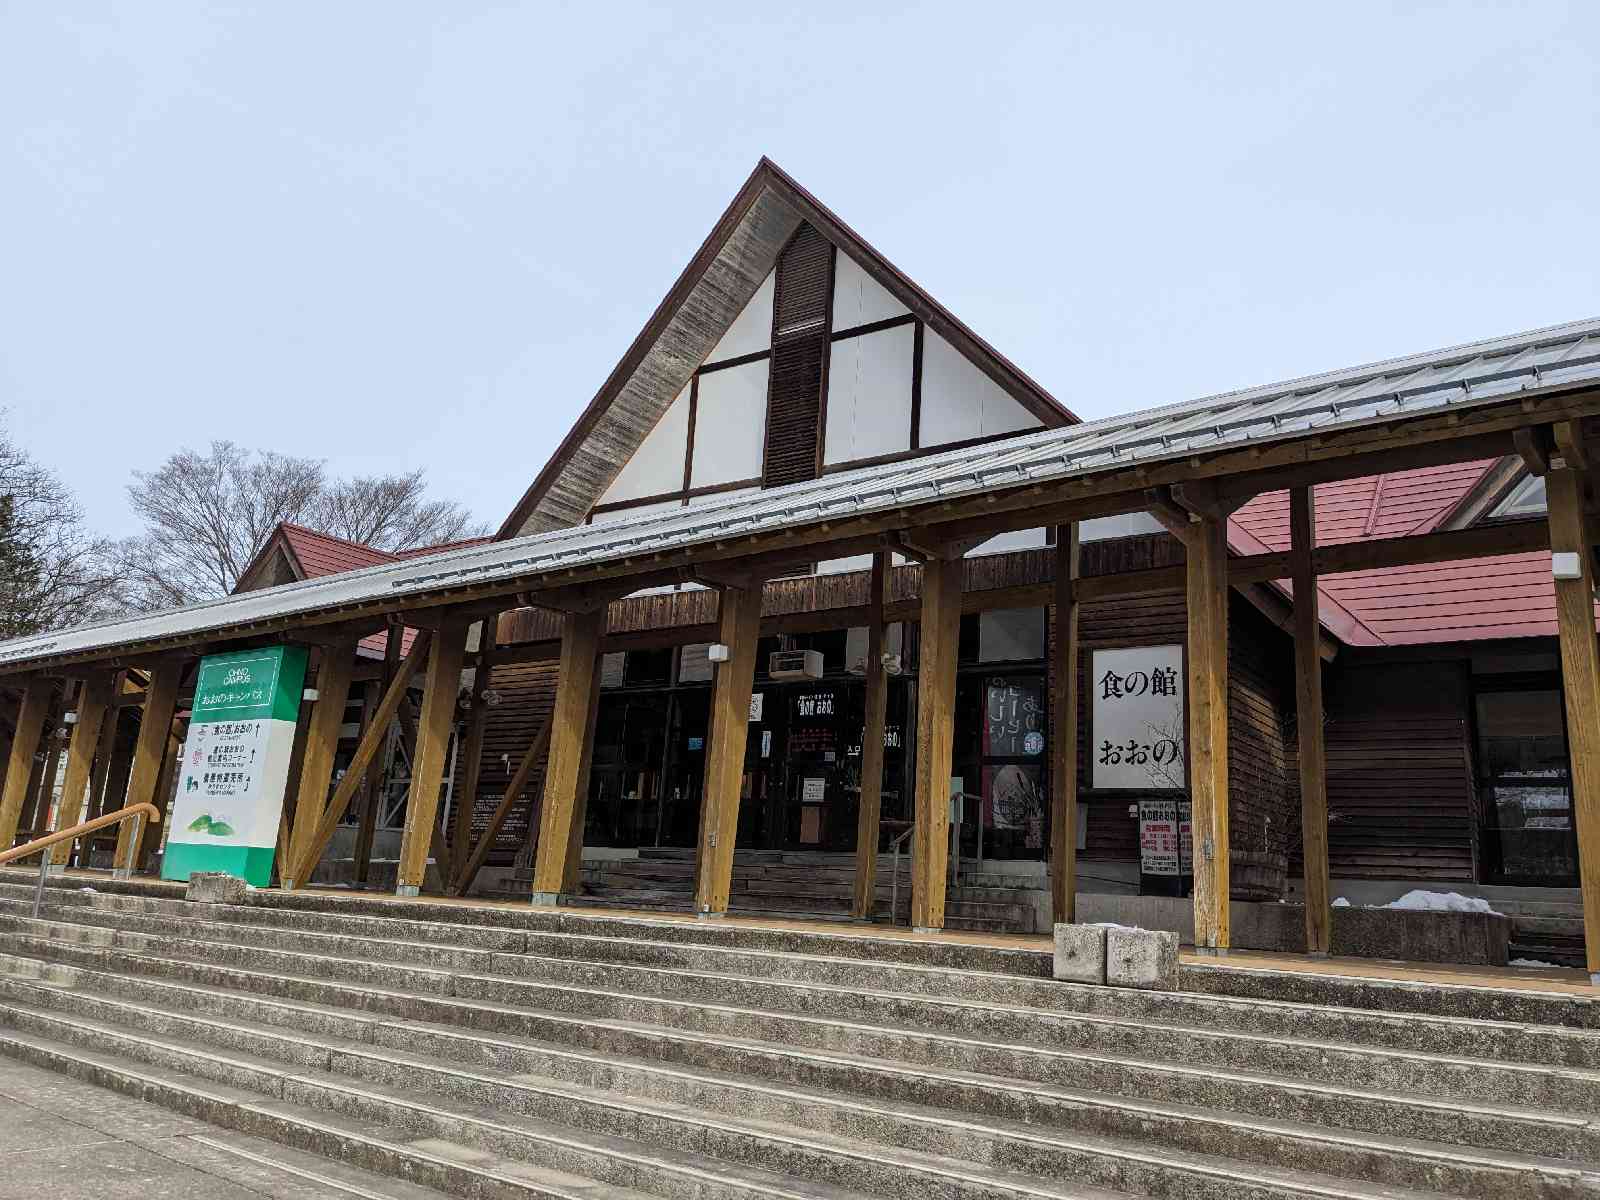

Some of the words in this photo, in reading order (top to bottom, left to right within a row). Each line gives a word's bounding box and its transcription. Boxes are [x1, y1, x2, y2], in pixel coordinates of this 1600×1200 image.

[1098, 667, 1177, 700] 食の館
[1099, 739, 1178, 765] おおの
